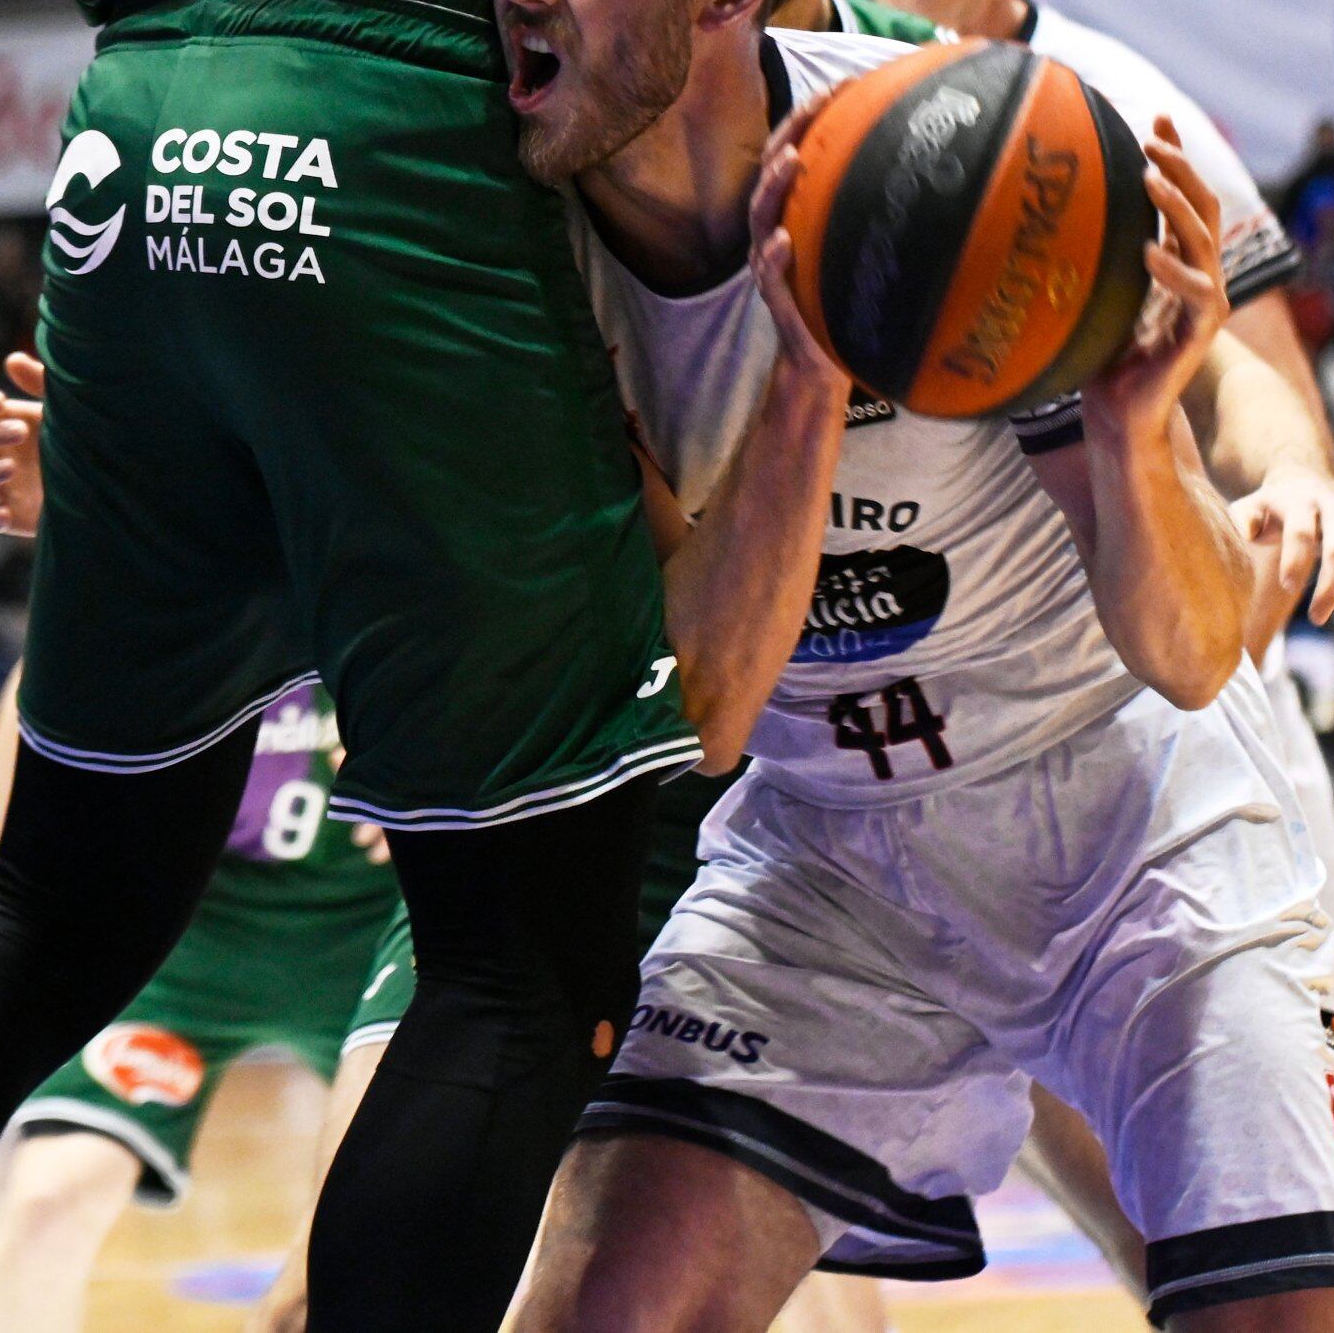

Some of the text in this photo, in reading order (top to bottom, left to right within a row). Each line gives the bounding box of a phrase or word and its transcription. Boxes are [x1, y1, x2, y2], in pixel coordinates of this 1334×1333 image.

[151, 127, 339, 189] COSTA
[145, 184, 331, 237] DEL SOL
[145, 226, 327, 284] MÁLAGA
[828, 676, 954, 781] 44
